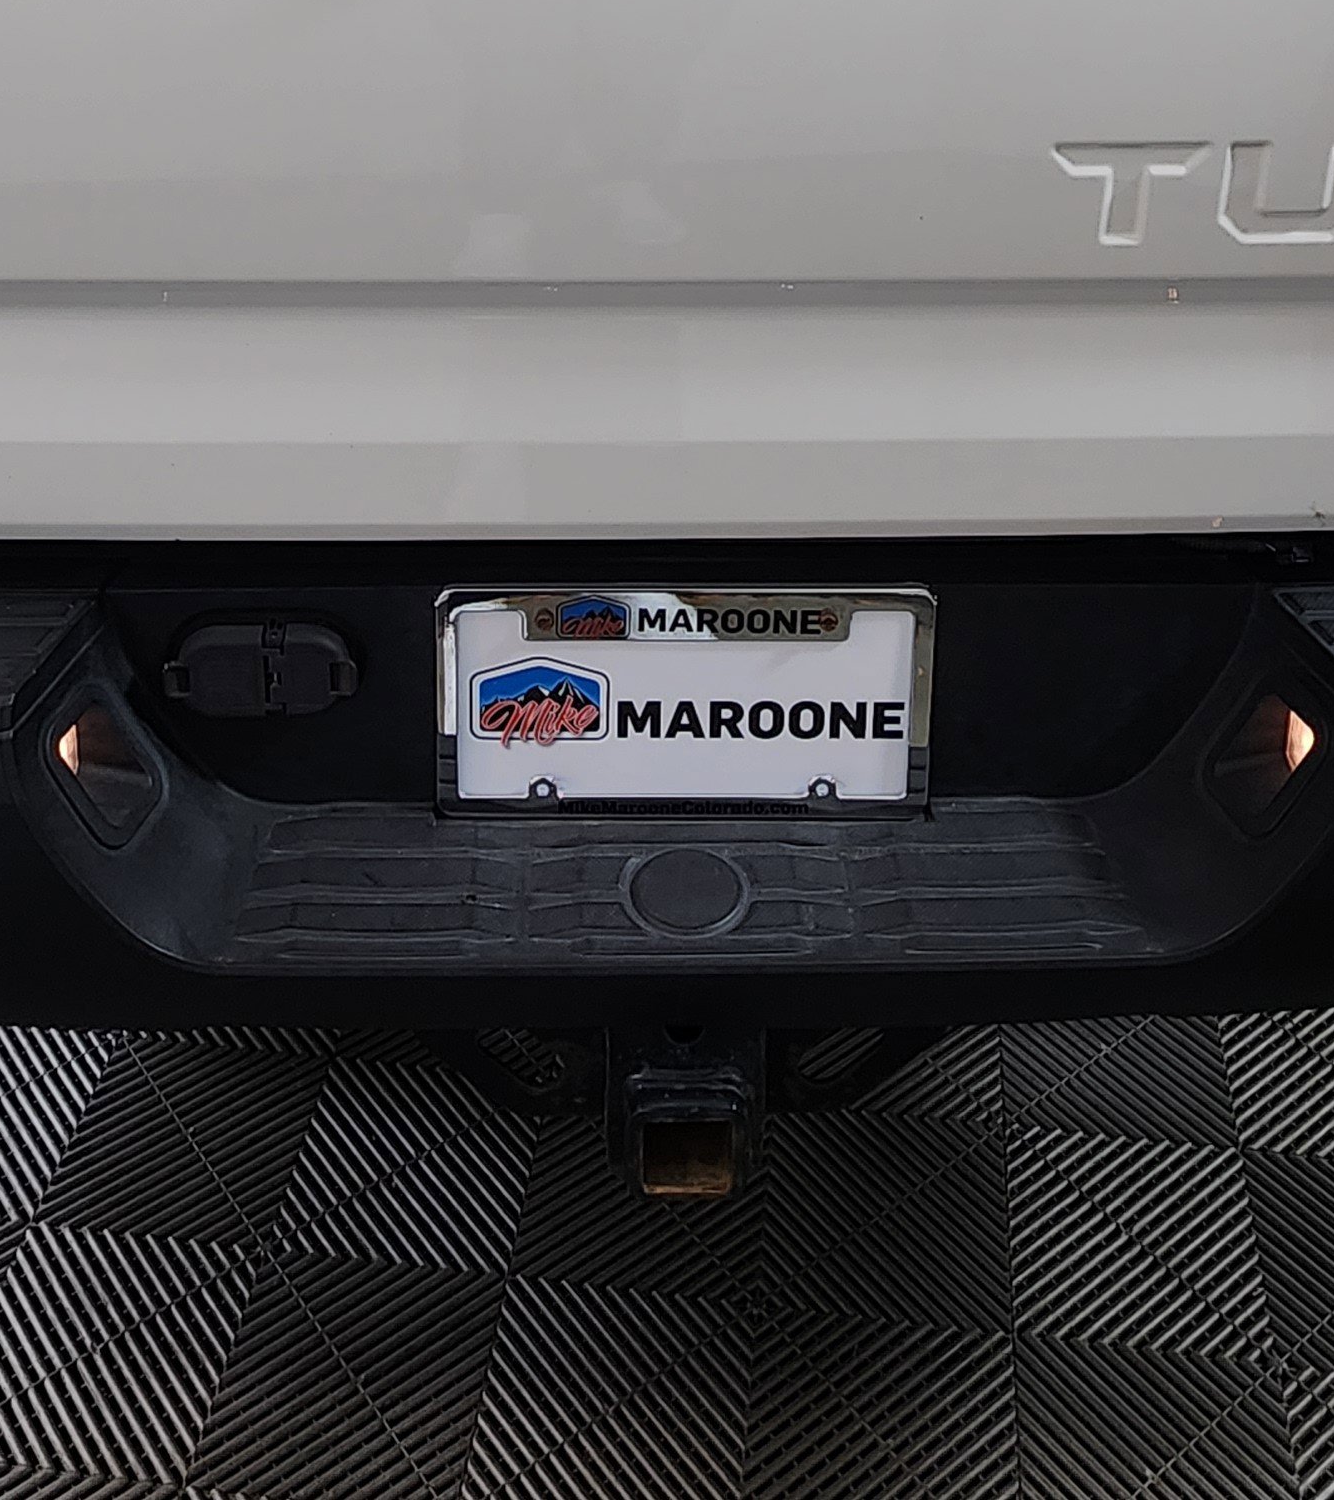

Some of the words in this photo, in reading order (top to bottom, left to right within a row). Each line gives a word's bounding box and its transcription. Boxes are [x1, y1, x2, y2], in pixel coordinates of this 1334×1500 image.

[562, 614, 624, 640] Mike
[638, 608, 823, 635] MAROONE
[481, 695, 600, 749] Mike
[616, 701, 906, 740] MAROONE
[557, 800, 810, 815] MikeMarooneColorado.com
